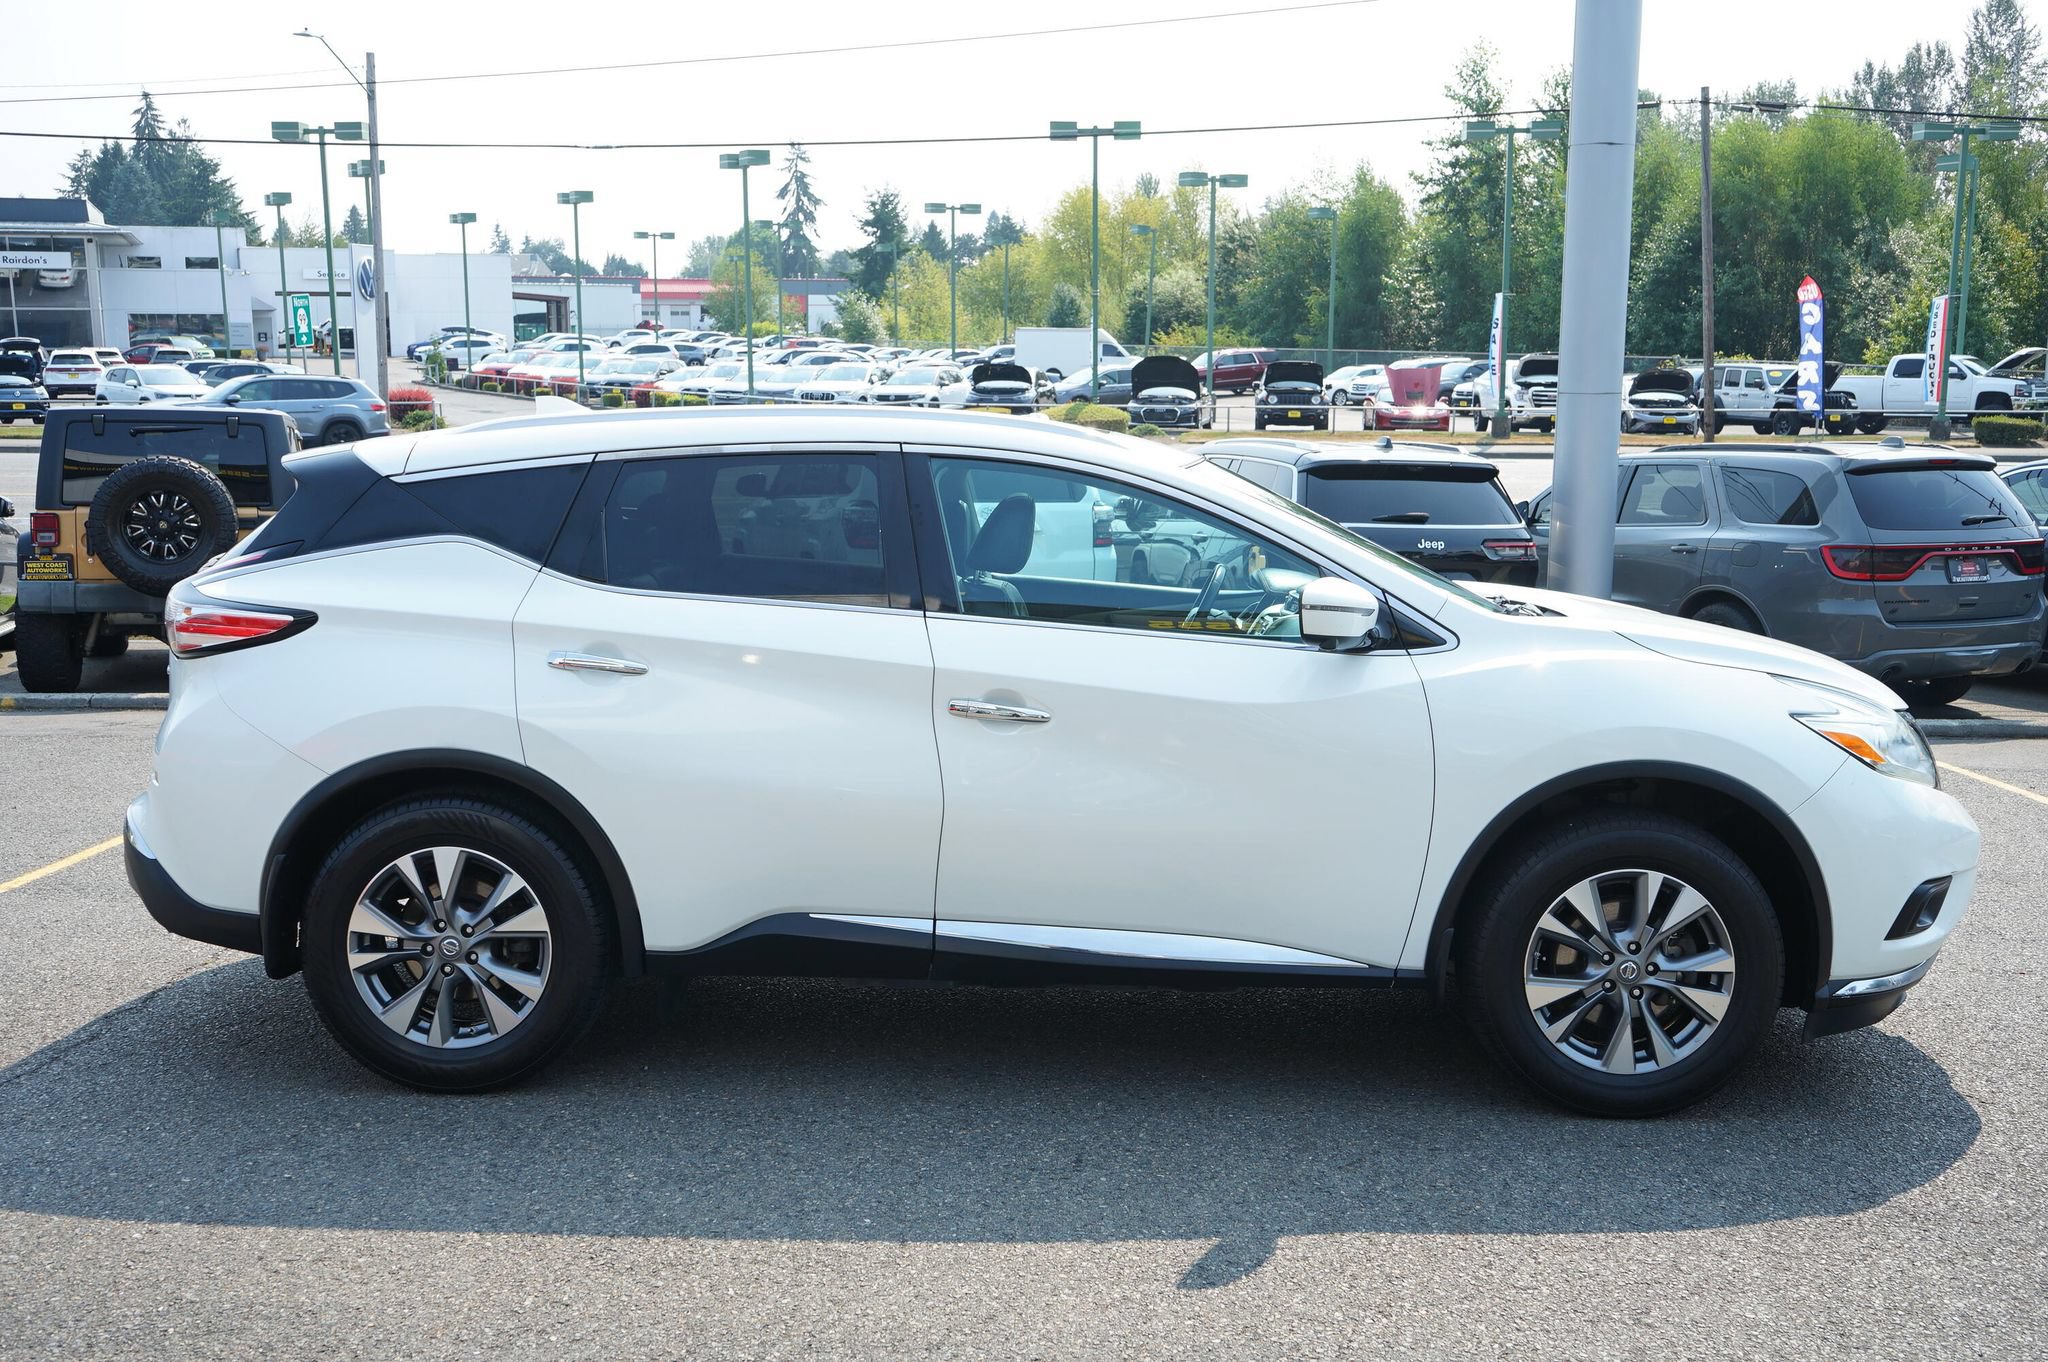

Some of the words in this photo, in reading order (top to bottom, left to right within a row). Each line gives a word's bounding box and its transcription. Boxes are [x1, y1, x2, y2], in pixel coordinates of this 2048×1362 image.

[2, 255, 48, 264] Rairdon's
[299, 313, 306, 325] 99
[1931, 303, 1940, 338] USED
[1491, 318, 1499, 375] SALE
[1417, 538, 1445, 551] Jeep
